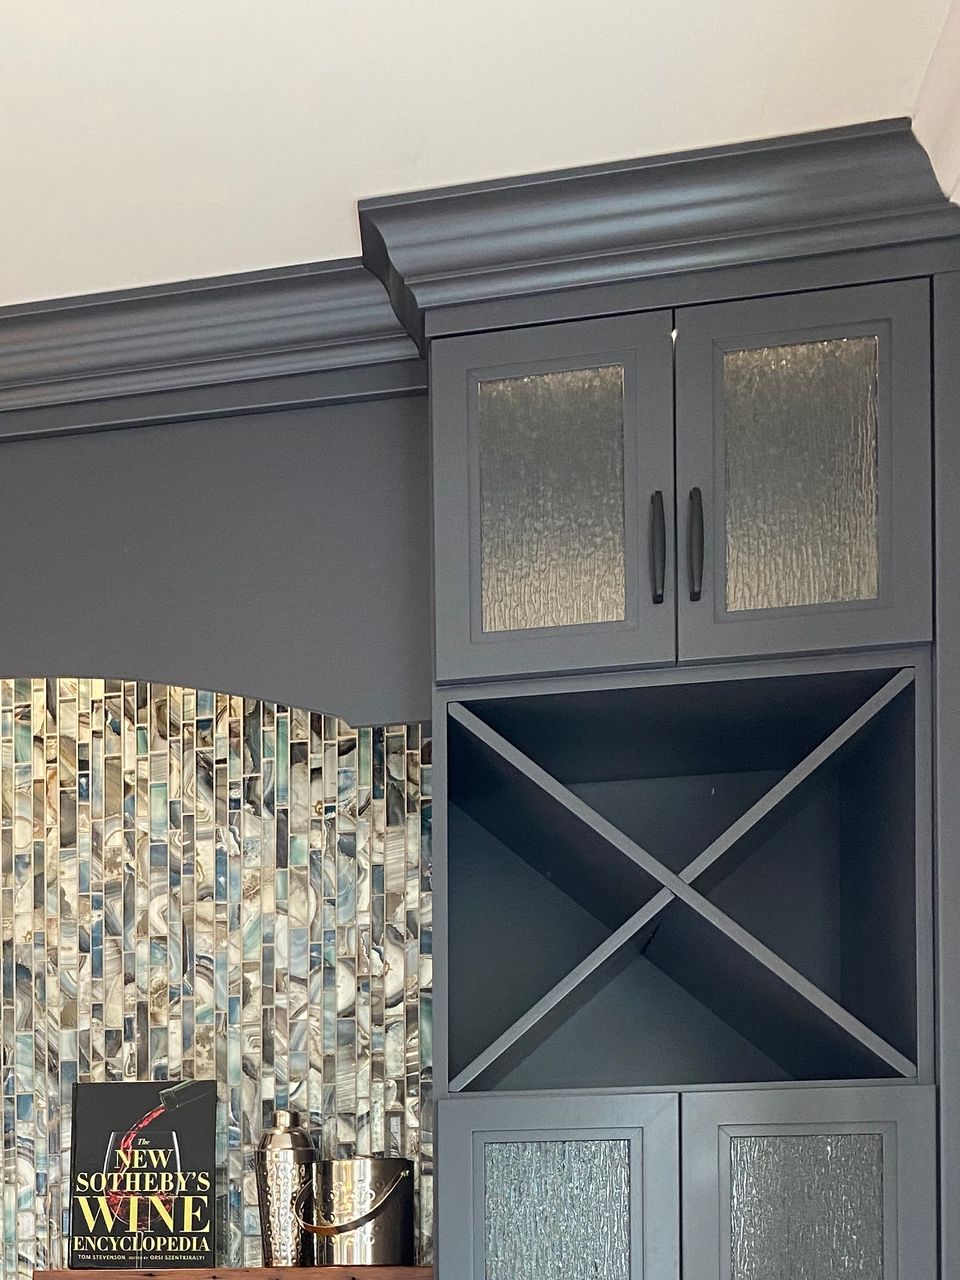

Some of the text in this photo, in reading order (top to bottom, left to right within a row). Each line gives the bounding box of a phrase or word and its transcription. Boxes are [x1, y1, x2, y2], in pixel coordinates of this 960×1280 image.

[137, 1138, 150, 1146] The
[114, 1148, 174, 1169] NEW
[75, 1171, 211, 1193] SOTHEBY'S
[73, 1195, 210, 1233] WINE
[73, 1235, 211, 1252] ENCYCLOPEDIA
